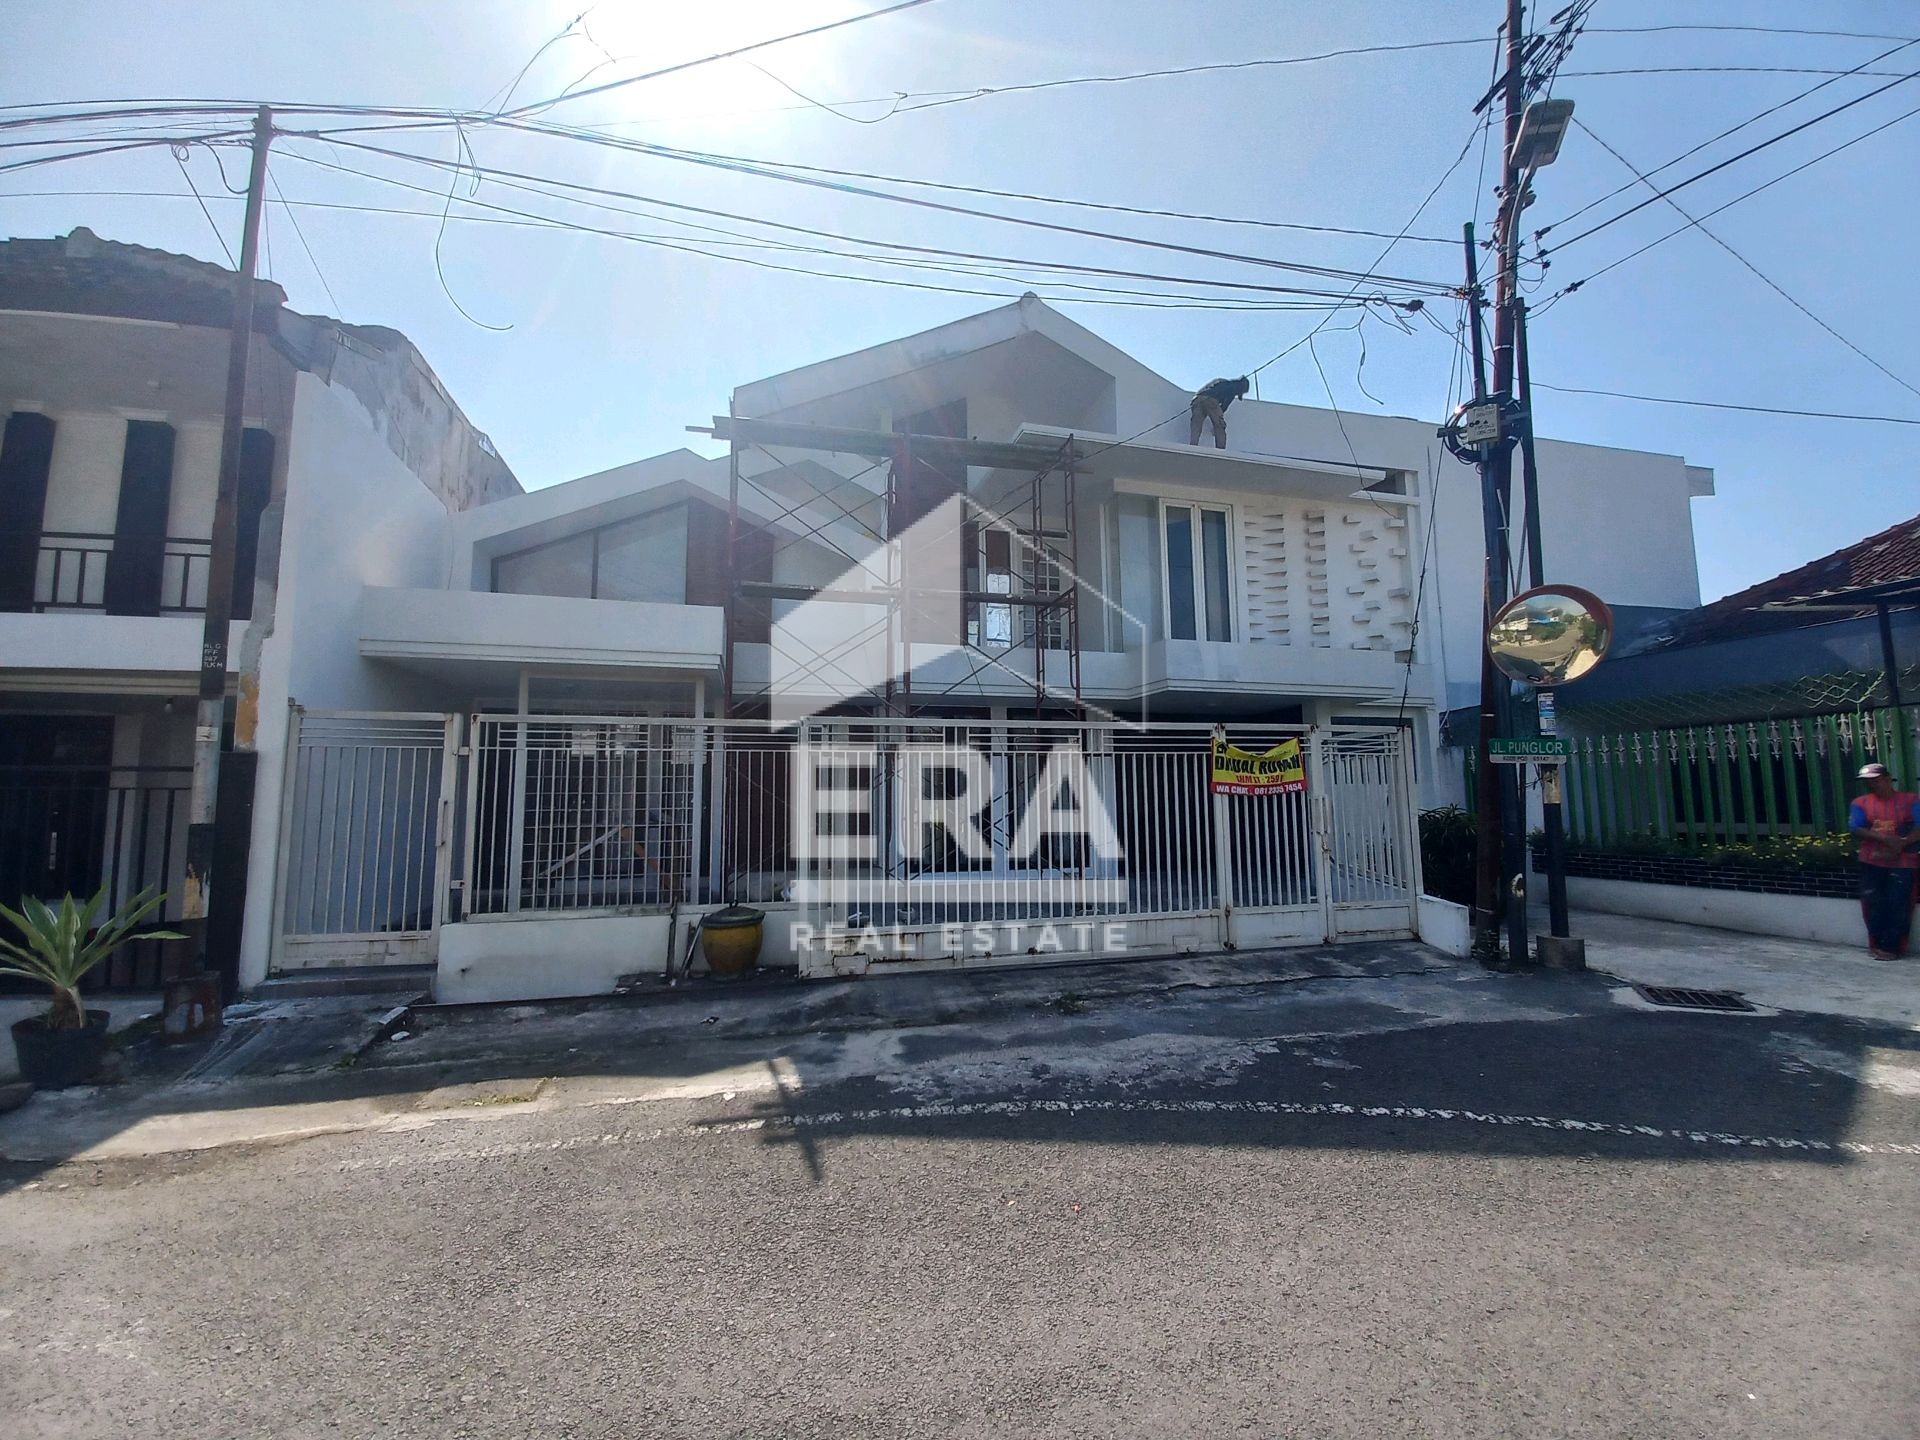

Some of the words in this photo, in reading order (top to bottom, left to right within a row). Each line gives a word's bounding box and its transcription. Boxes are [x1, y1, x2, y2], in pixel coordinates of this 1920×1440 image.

[1509, 742, 1563, 754] PUNGLOR
[1259, 754, 1301, 774] RUMAH
[1216, 785, 1230, 793] WA
[1231, 786, 1249, 795] CHAT
